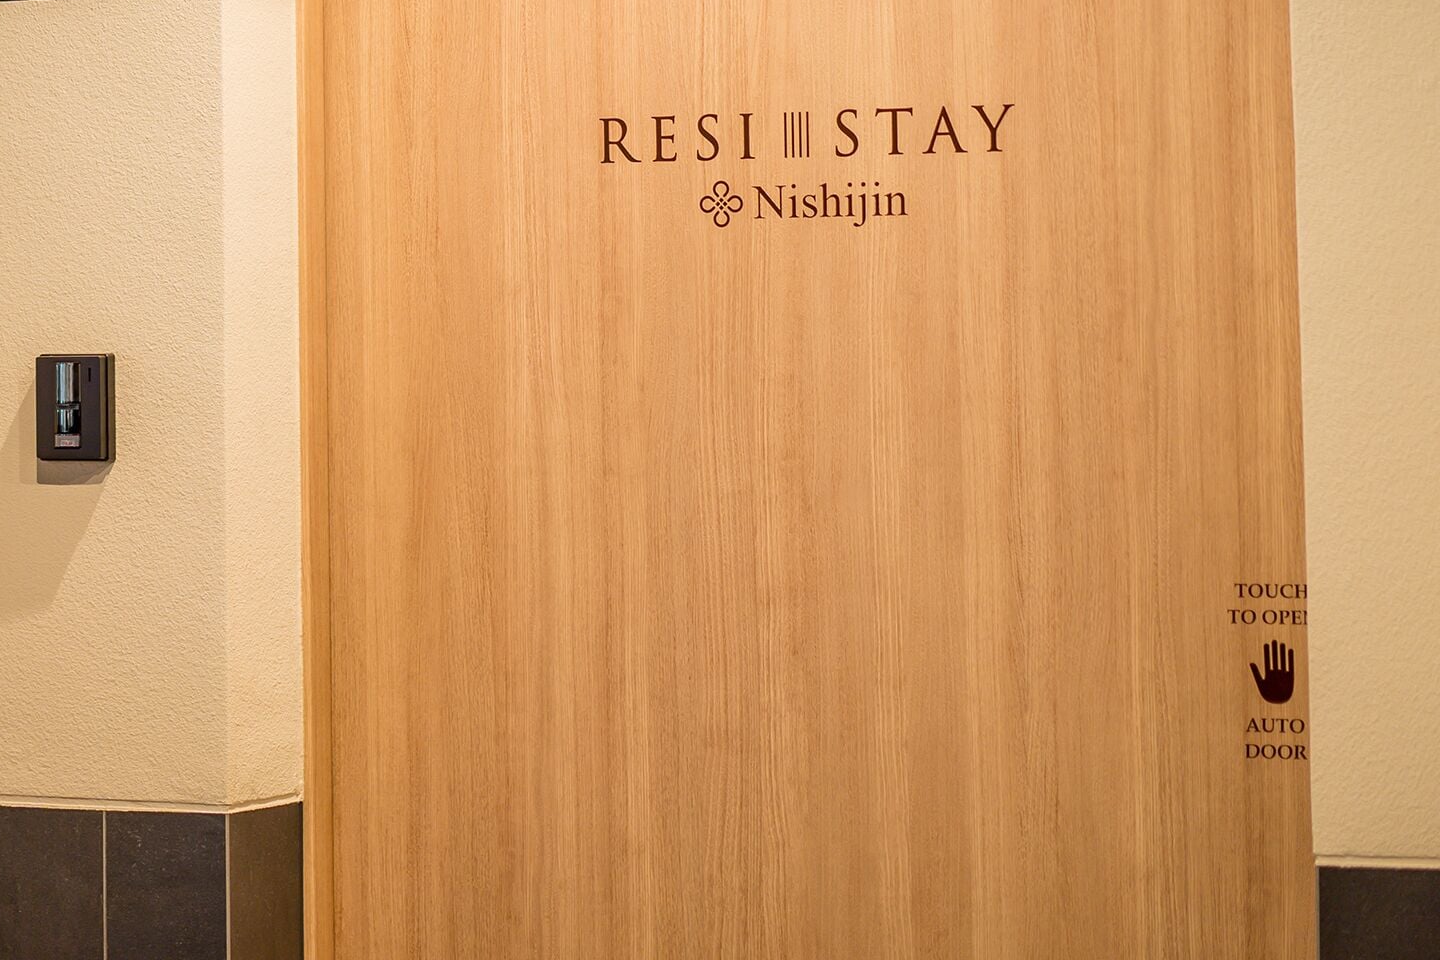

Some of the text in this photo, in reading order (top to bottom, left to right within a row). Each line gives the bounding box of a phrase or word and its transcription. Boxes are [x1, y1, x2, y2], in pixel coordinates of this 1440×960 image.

[599, 103, 1016, 164] RESI STAY
[751, 181, 909, 228] Nishijin
[1233, 582, 1308, 600] TOUCH
[1226, 608, 1258, 626] TO
[1245, 717, 1306, 735] AUTO
[1244, 743, 1308, 761] DOOR
